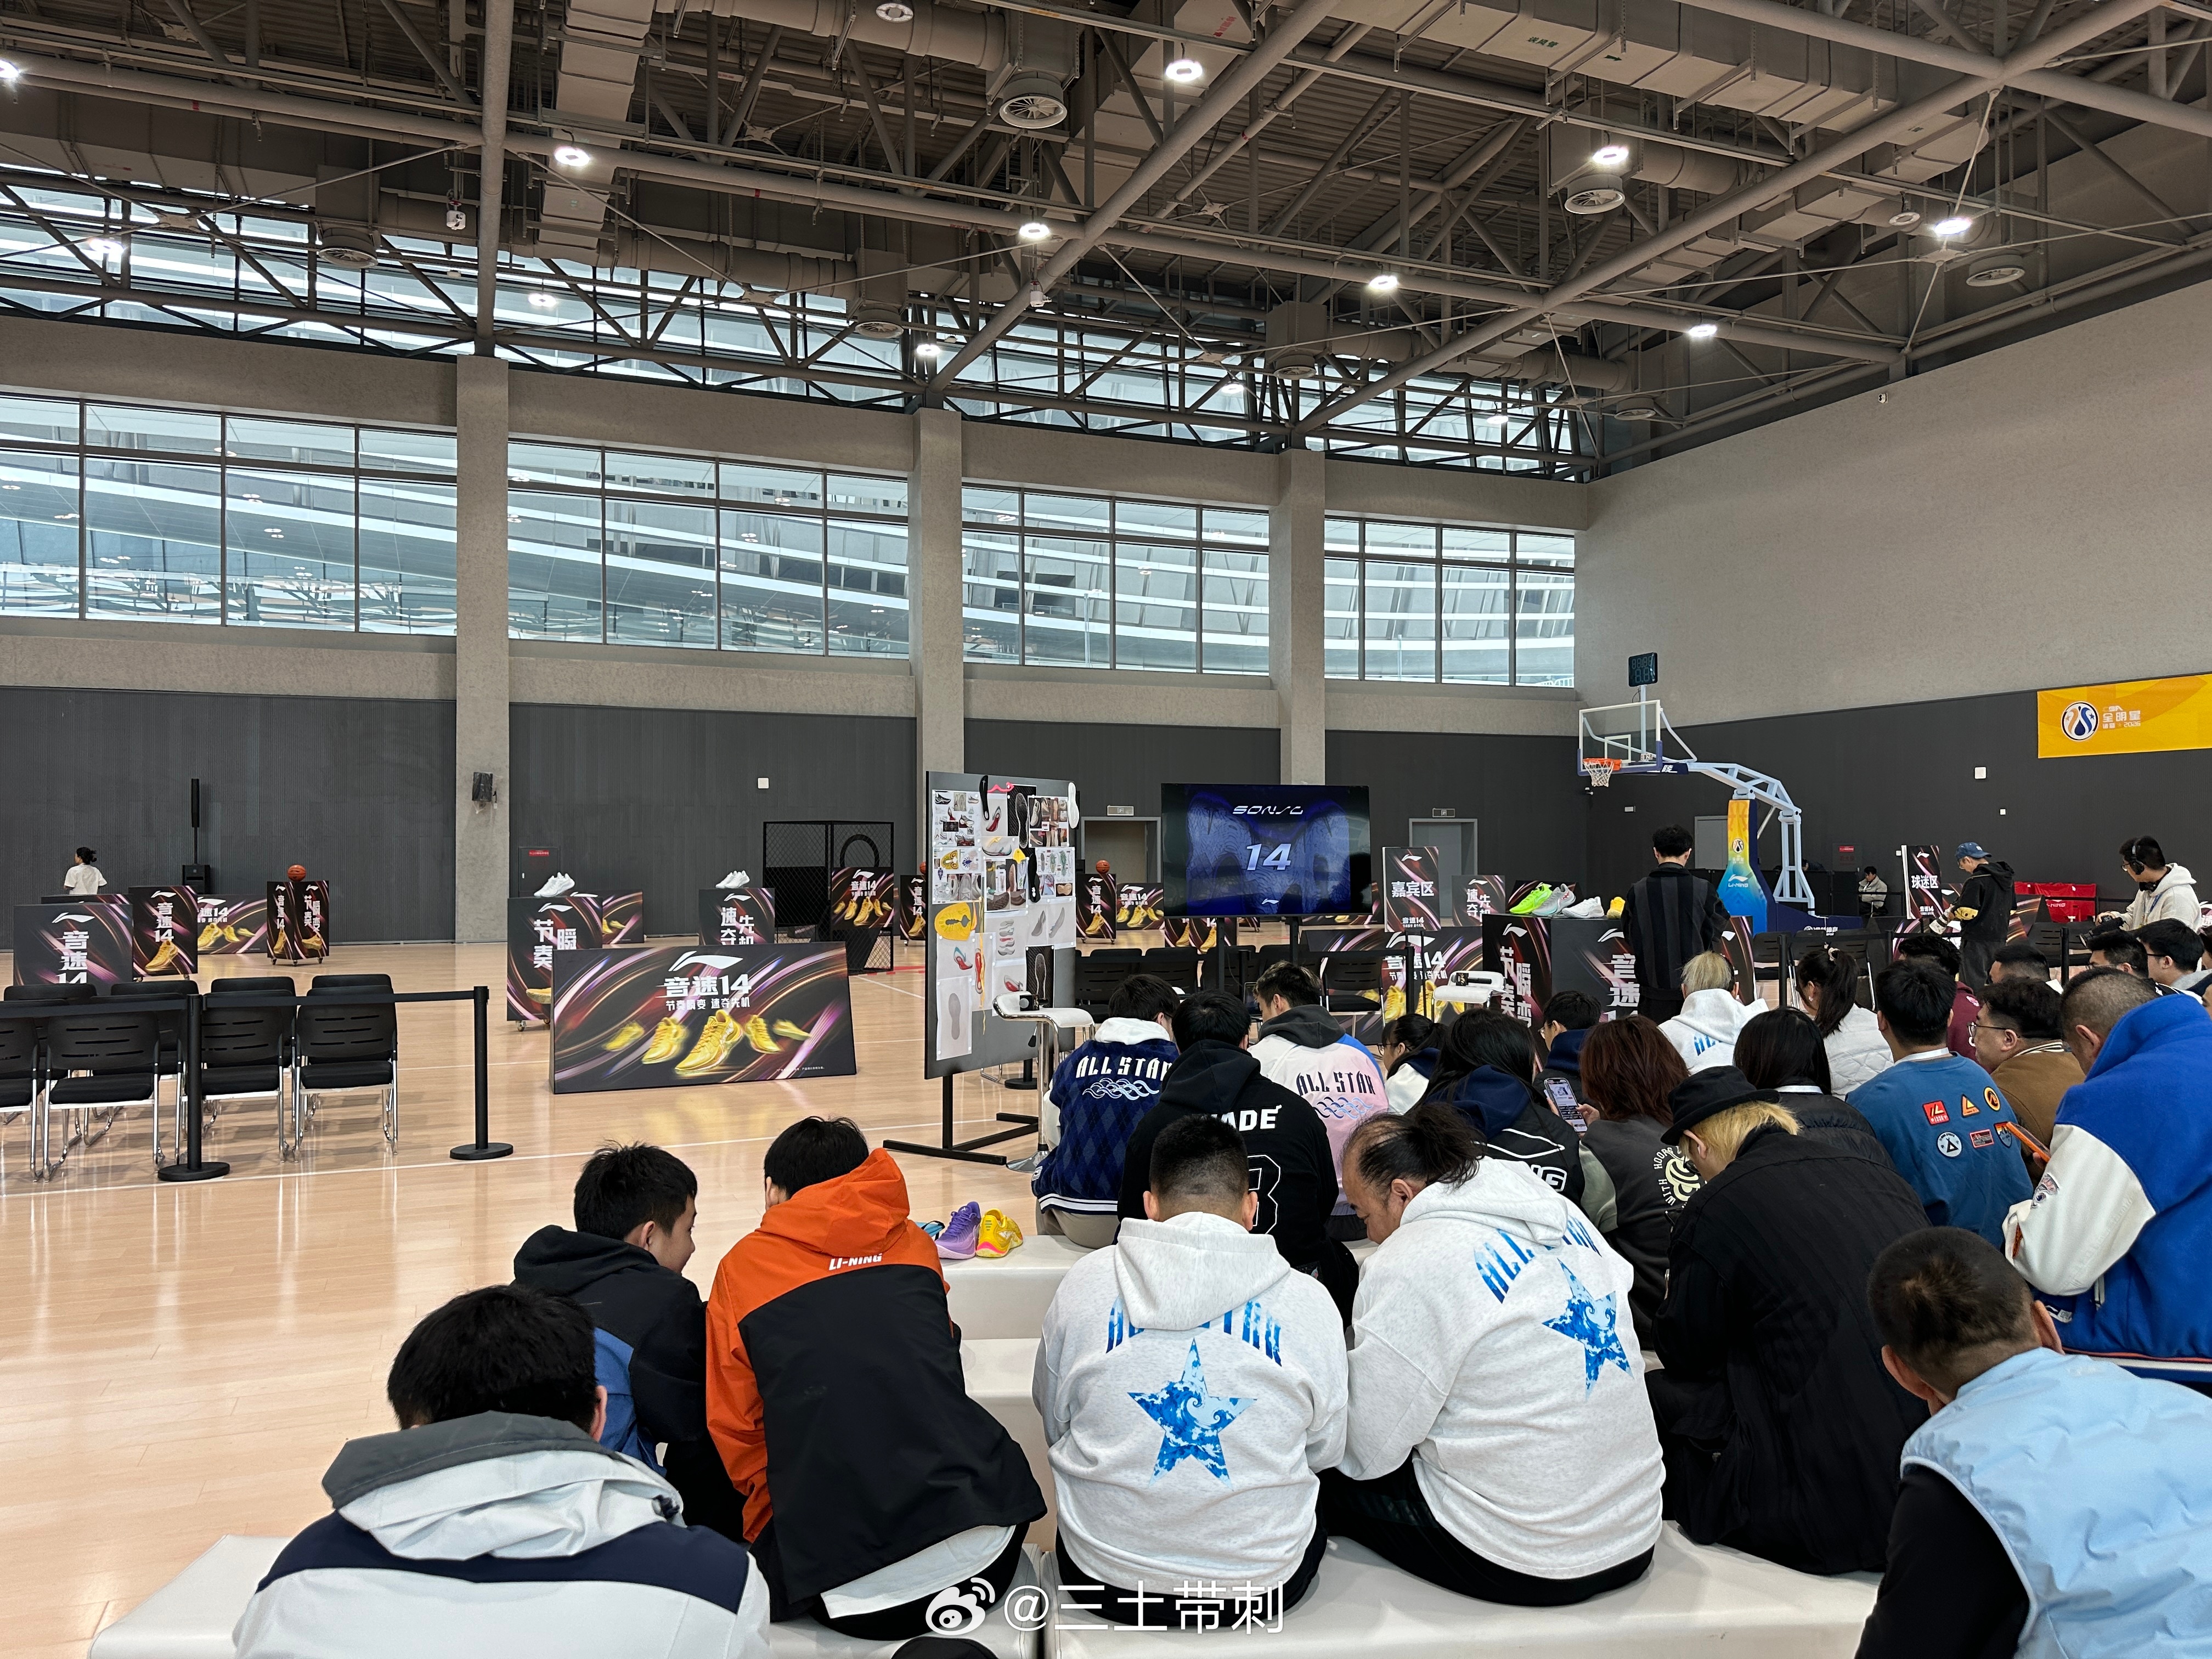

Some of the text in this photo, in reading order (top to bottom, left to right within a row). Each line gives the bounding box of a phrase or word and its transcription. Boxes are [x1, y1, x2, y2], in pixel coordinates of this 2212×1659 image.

[2103, 710, 2141, 723] 全明星
[1246, 843, 1291, 871] 14
[851, 880, 877, 891] 音速14
[1391, 881, 1435, 898] 嘉宾区
[1911, 875, 1939, 889] 球迷区
[154, 902, 174, 943] 音速14
[198, 907, 229, 918] 速14
[533, 919, 554, 968] 节奏
[661, 974, 752, 997] 音速14
[665, 997, 750, 1011] 节奏瞬变 速夺先机
[1076, 1056, 1112, 1079] ALL
[1296, 1071, 1376, 1097] ALL STAR
[1211, 1104, 1282, 1131] ADE
[1658, 1178, 1676, 1206] WITH
[828, 1253, 883, 1271] LI-NING
